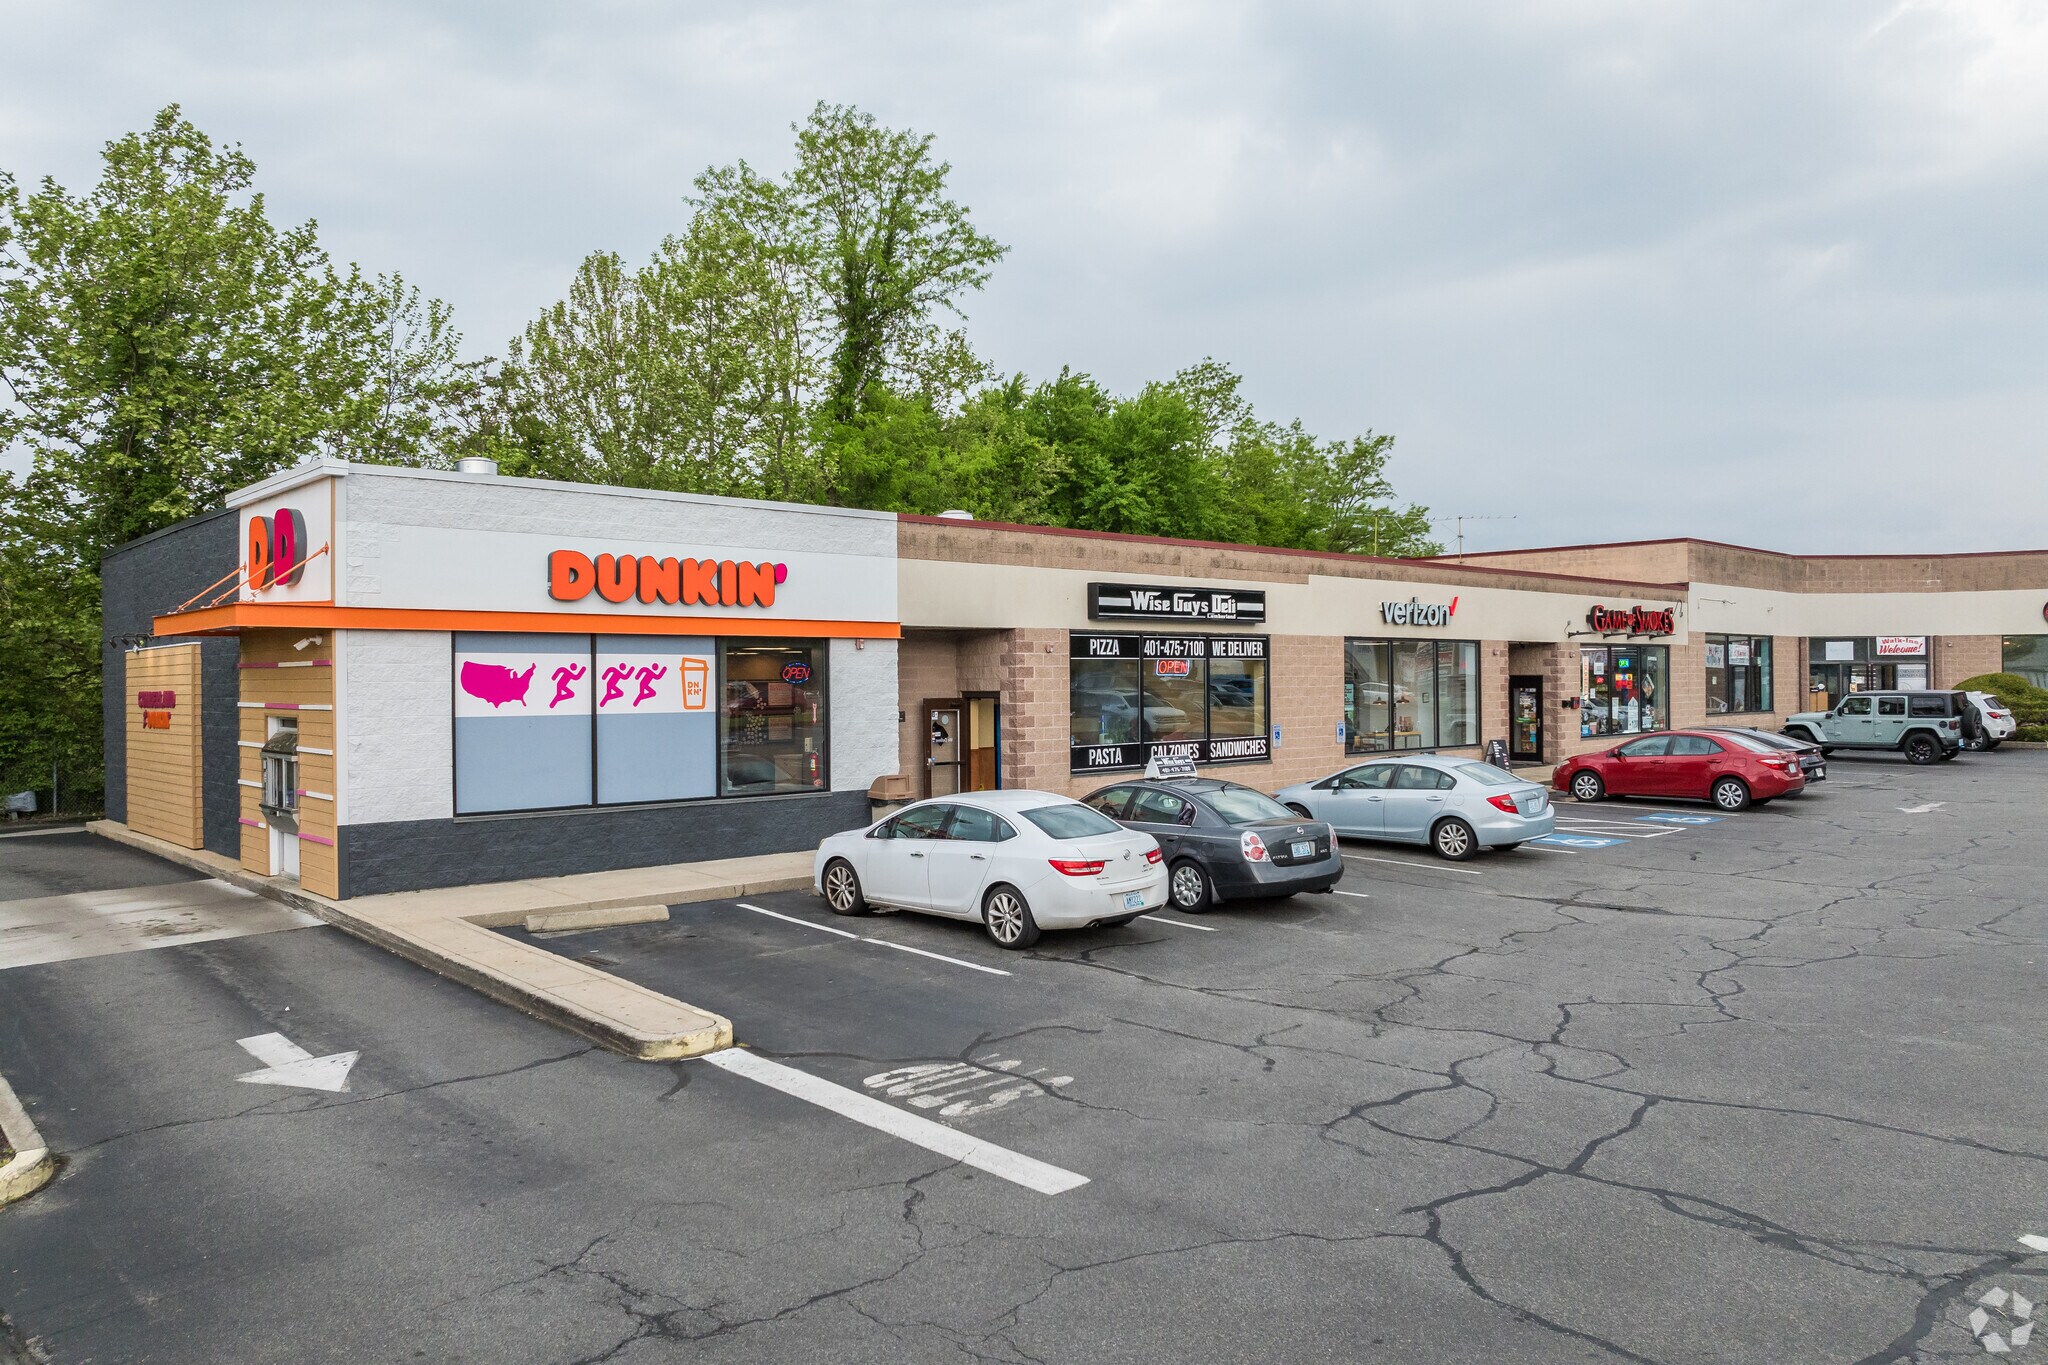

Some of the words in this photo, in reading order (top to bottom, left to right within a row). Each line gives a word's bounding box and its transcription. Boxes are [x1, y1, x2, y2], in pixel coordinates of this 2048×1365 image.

[548, 549, 787, 608] DUNKIN'
[1130, 590, 1171, 612] Wise
[1173, 593, 1209, 616] Guys
[1211, 594, 1237, 614] Deli
[1380, 596, 1450, 626] verizon
[1089, 638, 1120, 656] PIZZA
[1143, 640, 1205, 657] 401-475-7100
[1212, 641, 1225, 657] WE
[1227, 641, 1263, 657] DELIVER
[1879, 643, 1923, 655] Welcome!
[782, 666, 810, 680] OPEN
[1158, 660, 1188, 674] OPEN
[687, 681, 699, 689] DN
[1088, 747, 1123, 766] PASTA
[1151, 743, 1199, 759] CALZONES
[1210, 739, 1267, 759] SANDWICHES
